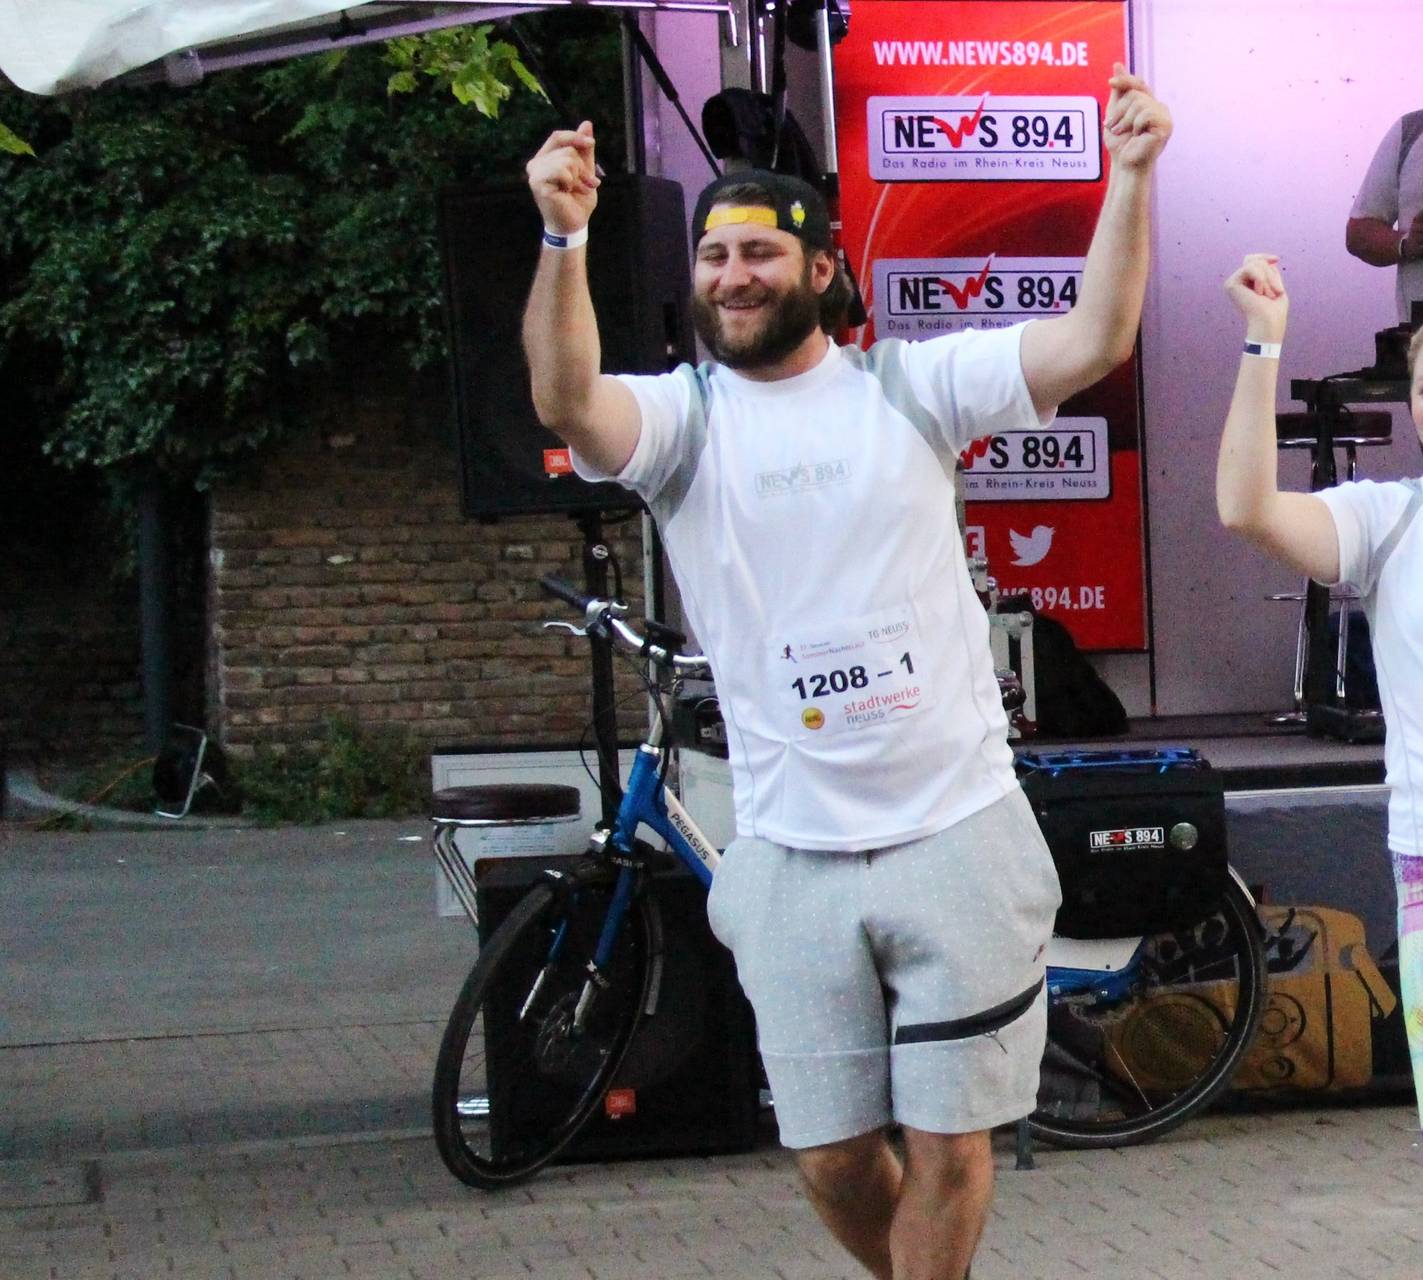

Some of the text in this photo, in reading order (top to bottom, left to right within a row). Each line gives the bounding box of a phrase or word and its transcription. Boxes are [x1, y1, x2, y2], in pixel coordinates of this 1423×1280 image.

[873, 41, 1088, 66] WWW.NEWS894.DE
[894, 99, 1073, 148] NEWS 89.4
[882, 157, 1088, 169] Das Radio im Rhein-Kreis Neuss
[900, 260, 1004, 310] NEWS
[888, 320, 910, 331] Das
[918, 319, 953, 330] Radio
[981, 318, 1015, 329] Rhein
[1022, 435, 1084, 468] 89.4
[985, 479, 1055, 489] Rhein-Kreis
[1062, 479, 1097, 489] Neuss
[792, 665, 869, 700] 1208
[900, 651, 914, 675] 1
[843, 686, 920, 715] stadtwerke
[671, 812, 710, 860] PEGASUS
